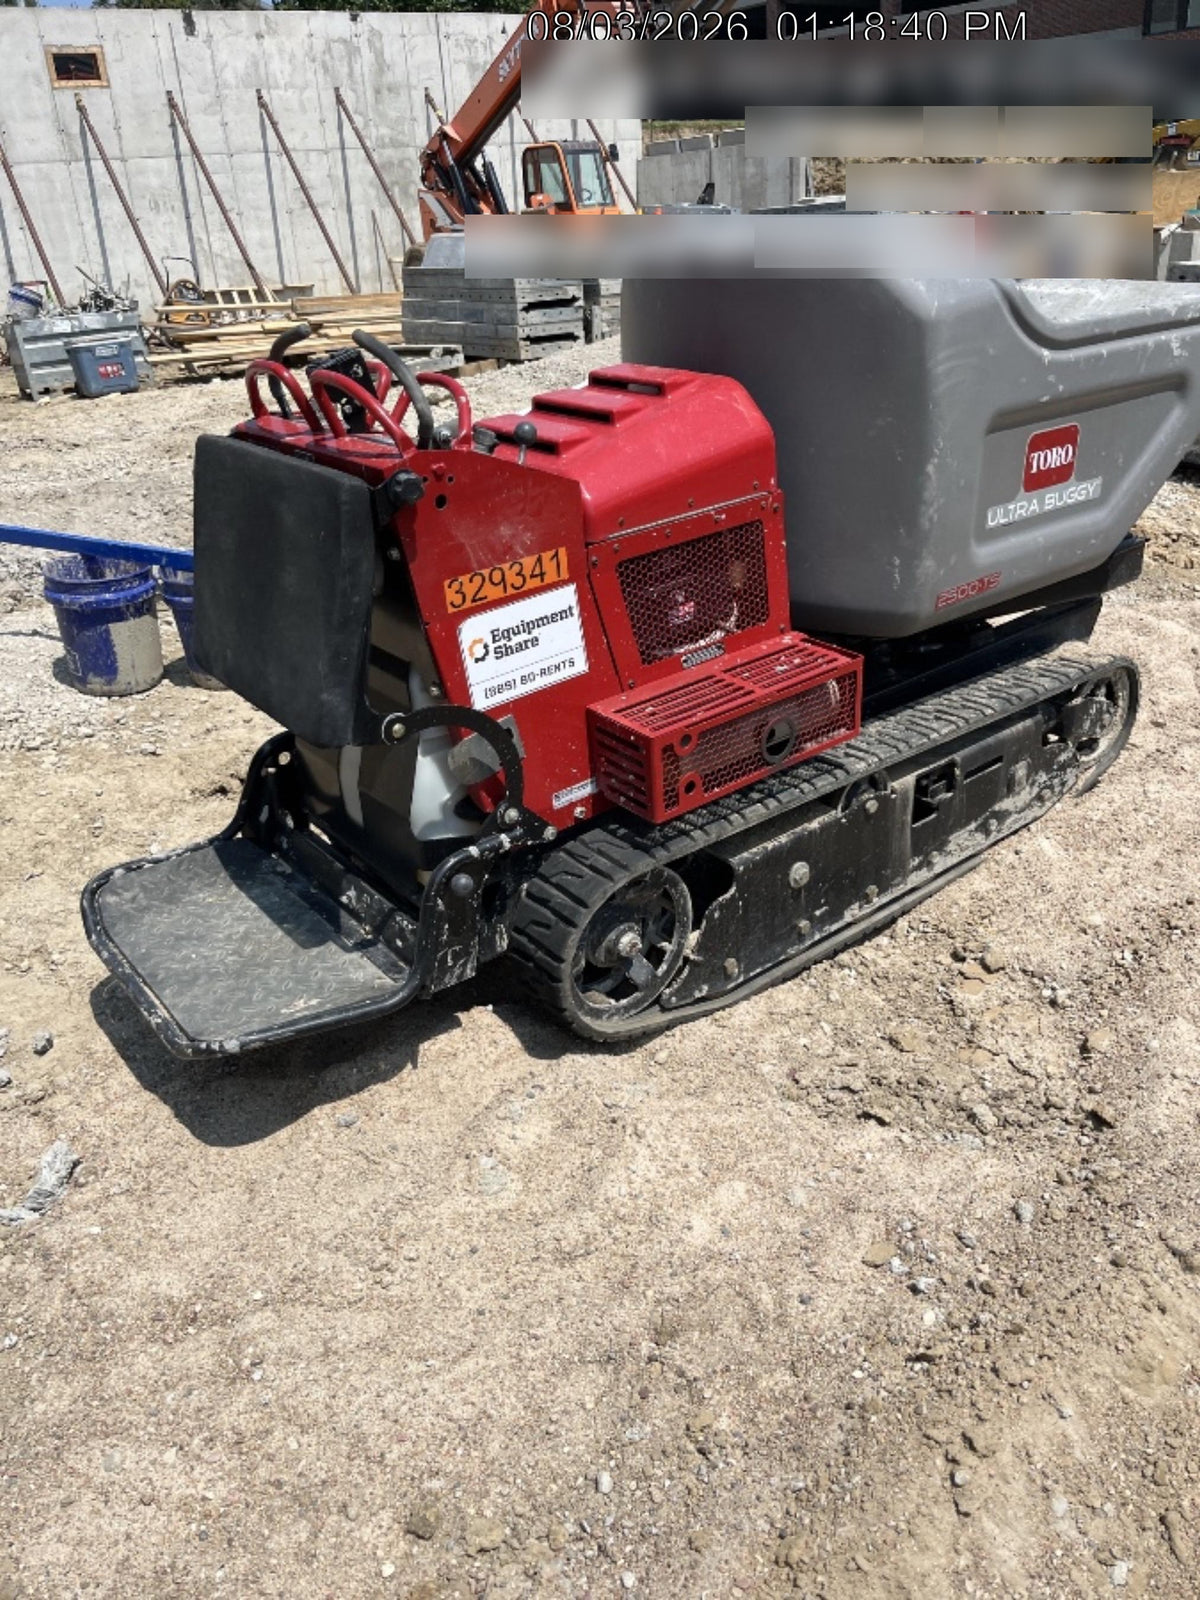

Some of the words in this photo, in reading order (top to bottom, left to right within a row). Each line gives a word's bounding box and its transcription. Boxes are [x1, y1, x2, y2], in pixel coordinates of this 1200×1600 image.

[1029, 444, 1073, 473] TORO
[987, 499, 1039, 526] ULTRA
[1044, 481, 1097, 510] BUGGY
[447, 548, 563, 609] 329341
[490, 604, 575, 644] Equipment
[493, 635, 540, 660] Share
